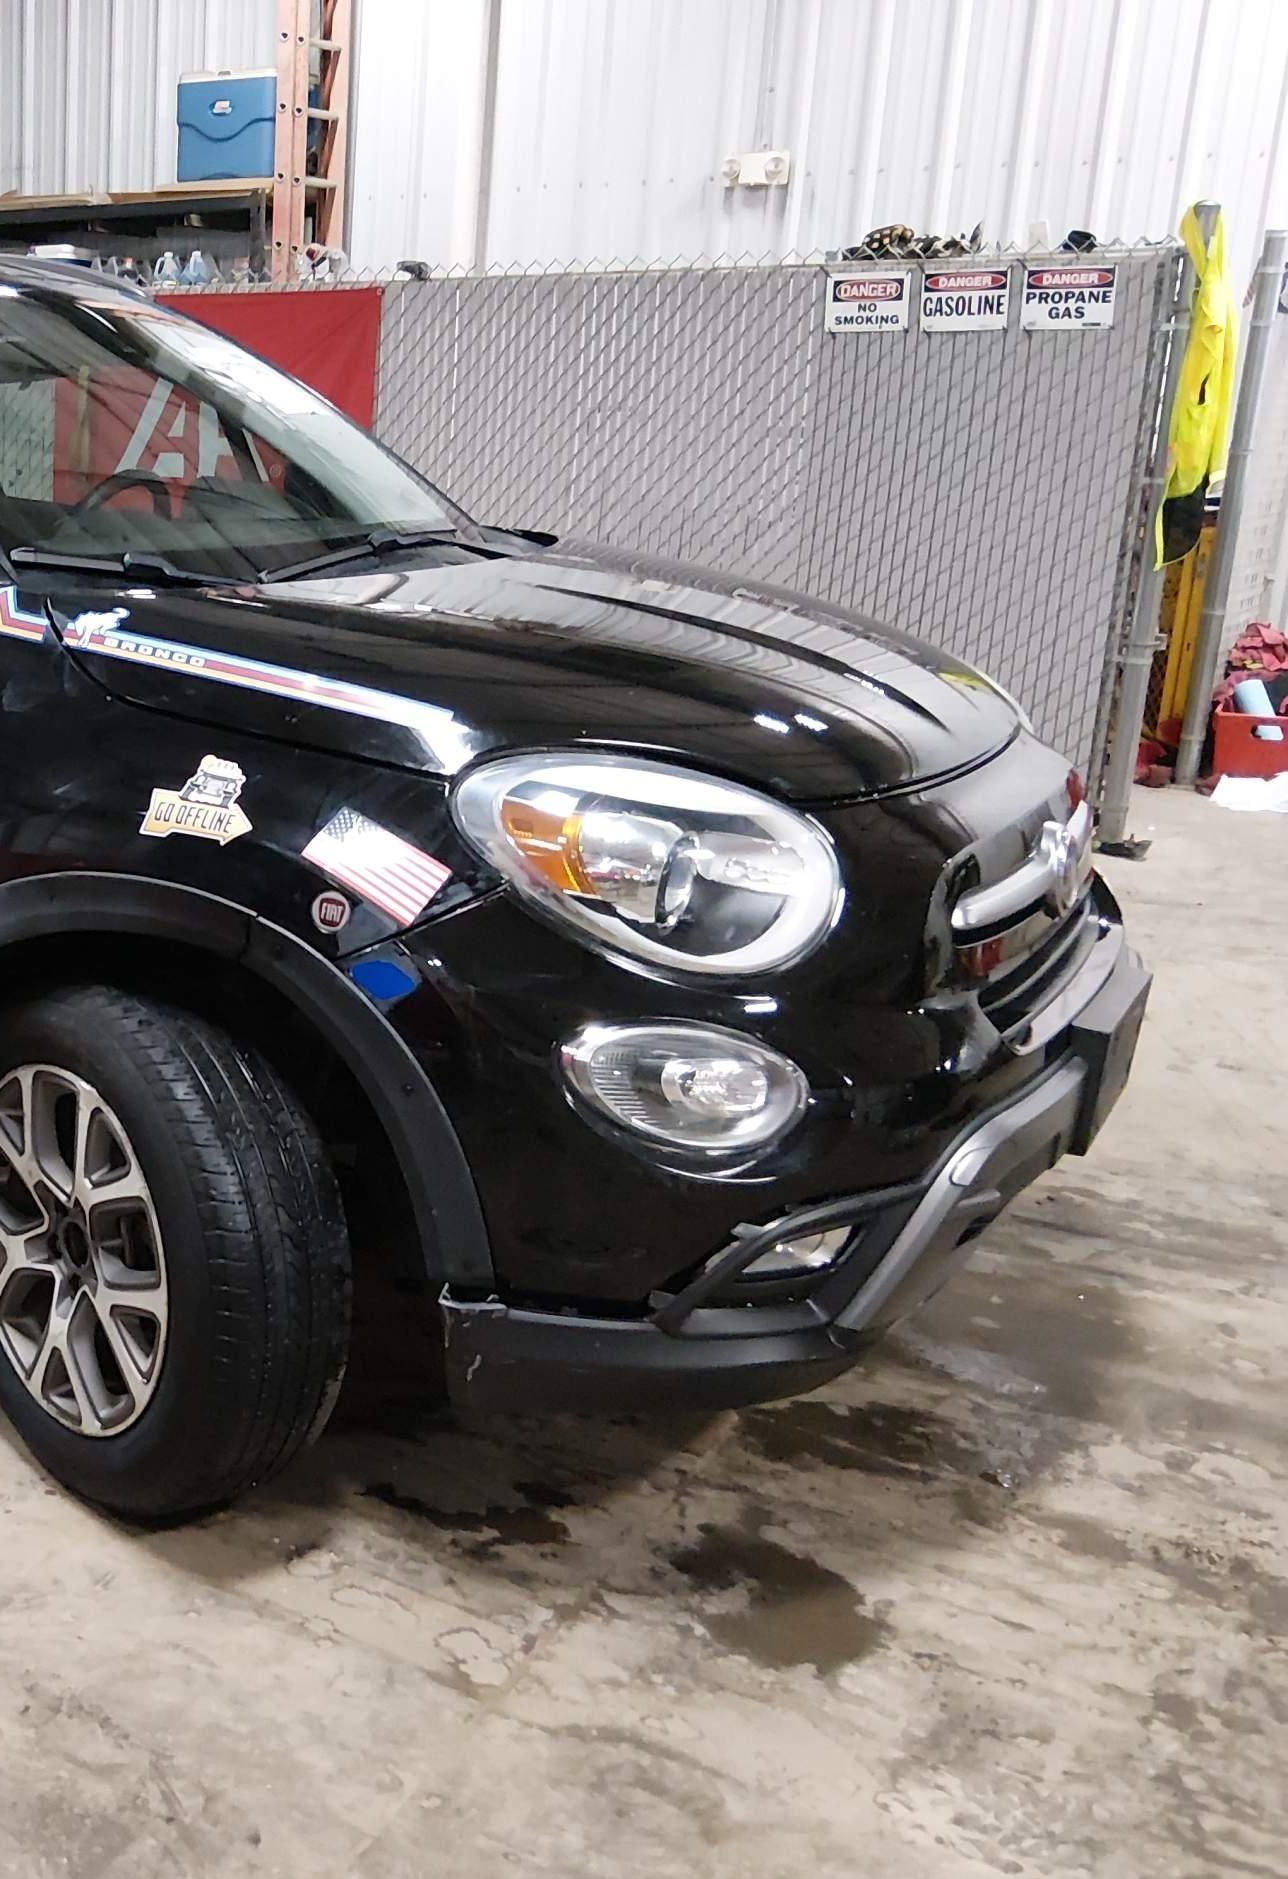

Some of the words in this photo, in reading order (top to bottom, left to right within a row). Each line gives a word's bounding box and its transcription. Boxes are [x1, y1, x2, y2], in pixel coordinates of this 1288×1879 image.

[938, 275, 992, 288] DANGER
[1042, 272, 1099, 285] DANGER
[840, 281, 897, 298] DANGER
[1025, 290, 1113, 305] PROPANE
[857, 302, 878, 313] NO
[922, 294, 1006, 318] GASOLINE
[1047, 306, 1086, 320] GAS
[834, 314, 900, 326] SMOKING
[103, 636, 207, 669] BRONCO
[154, 801, 176, 822] GO
[175, 804, 237, 835] OFFLINE
[320, 902, 345, 922] FIAT
